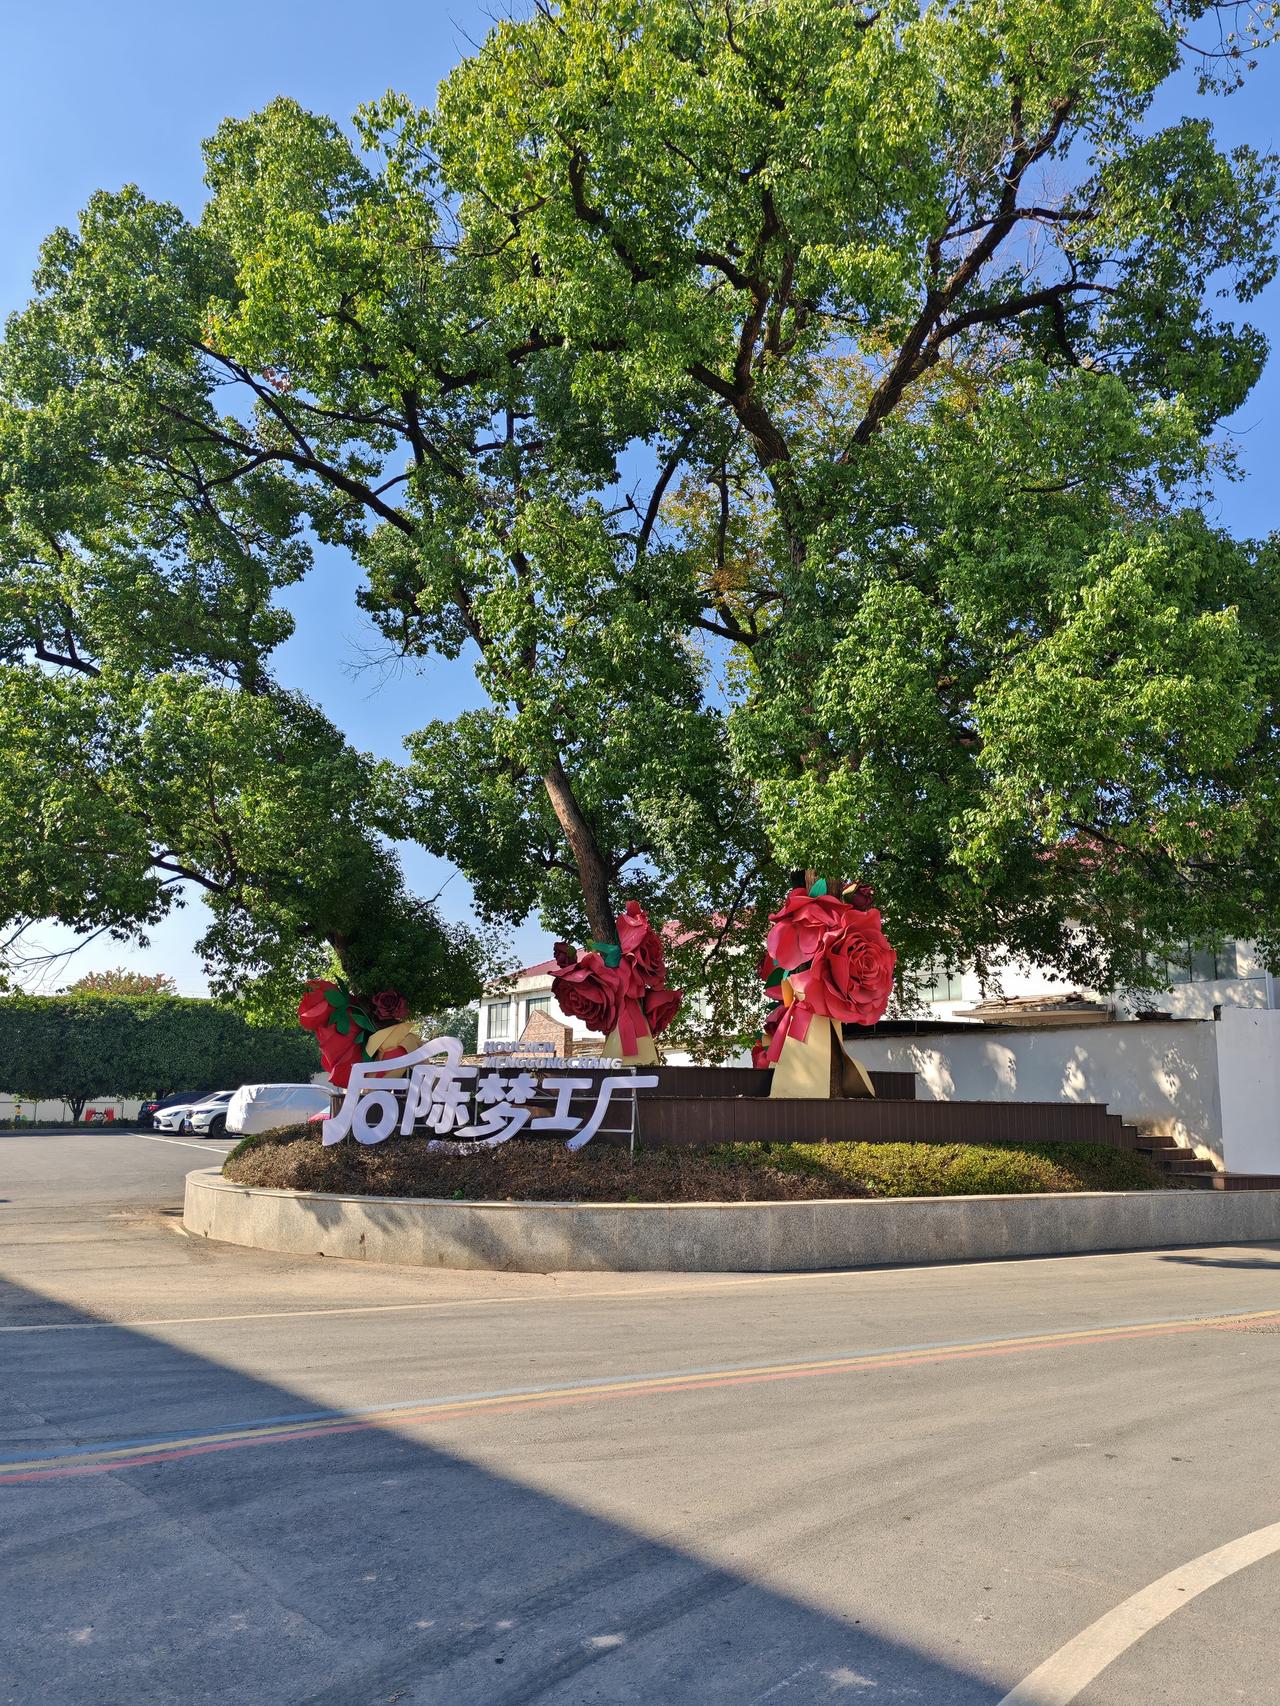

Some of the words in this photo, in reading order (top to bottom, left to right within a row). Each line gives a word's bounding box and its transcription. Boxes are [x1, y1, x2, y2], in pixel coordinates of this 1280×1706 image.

[483, 1041, 556, 1053] HOUCHEN
[323, 1036, 660, 1153] 后陈梦工厂
